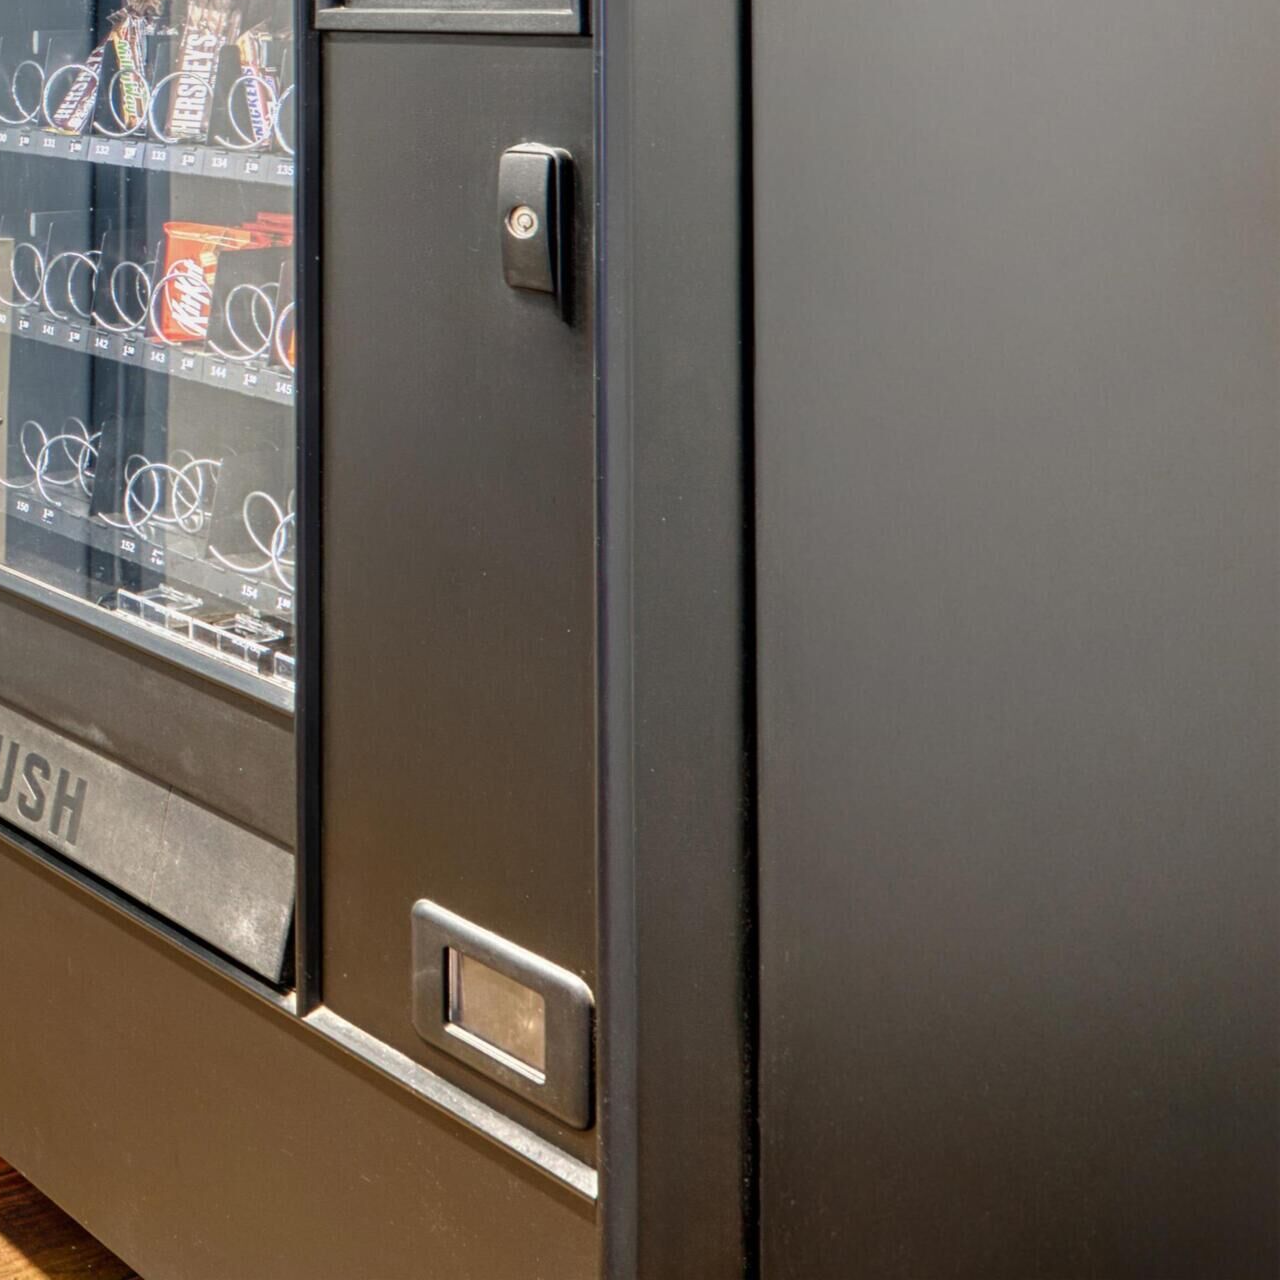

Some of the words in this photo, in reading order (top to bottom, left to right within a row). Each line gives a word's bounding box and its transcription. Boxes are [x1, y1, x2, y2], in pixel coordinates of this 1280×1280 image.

[211, 157, 228, 168] 134
[276, 164, 293, 175] 135
[42, 324, 55, 336] 141
[94, 337, 109, 349] 142
[150, 351, 166, 363] 143
[210, 366, 227, 378] 144
[274, 382, 293, 395] 145
[16, 501, 30, 513] 150
[120, 539, 136, 553] 152
[241, 584, 259, 599] 154
